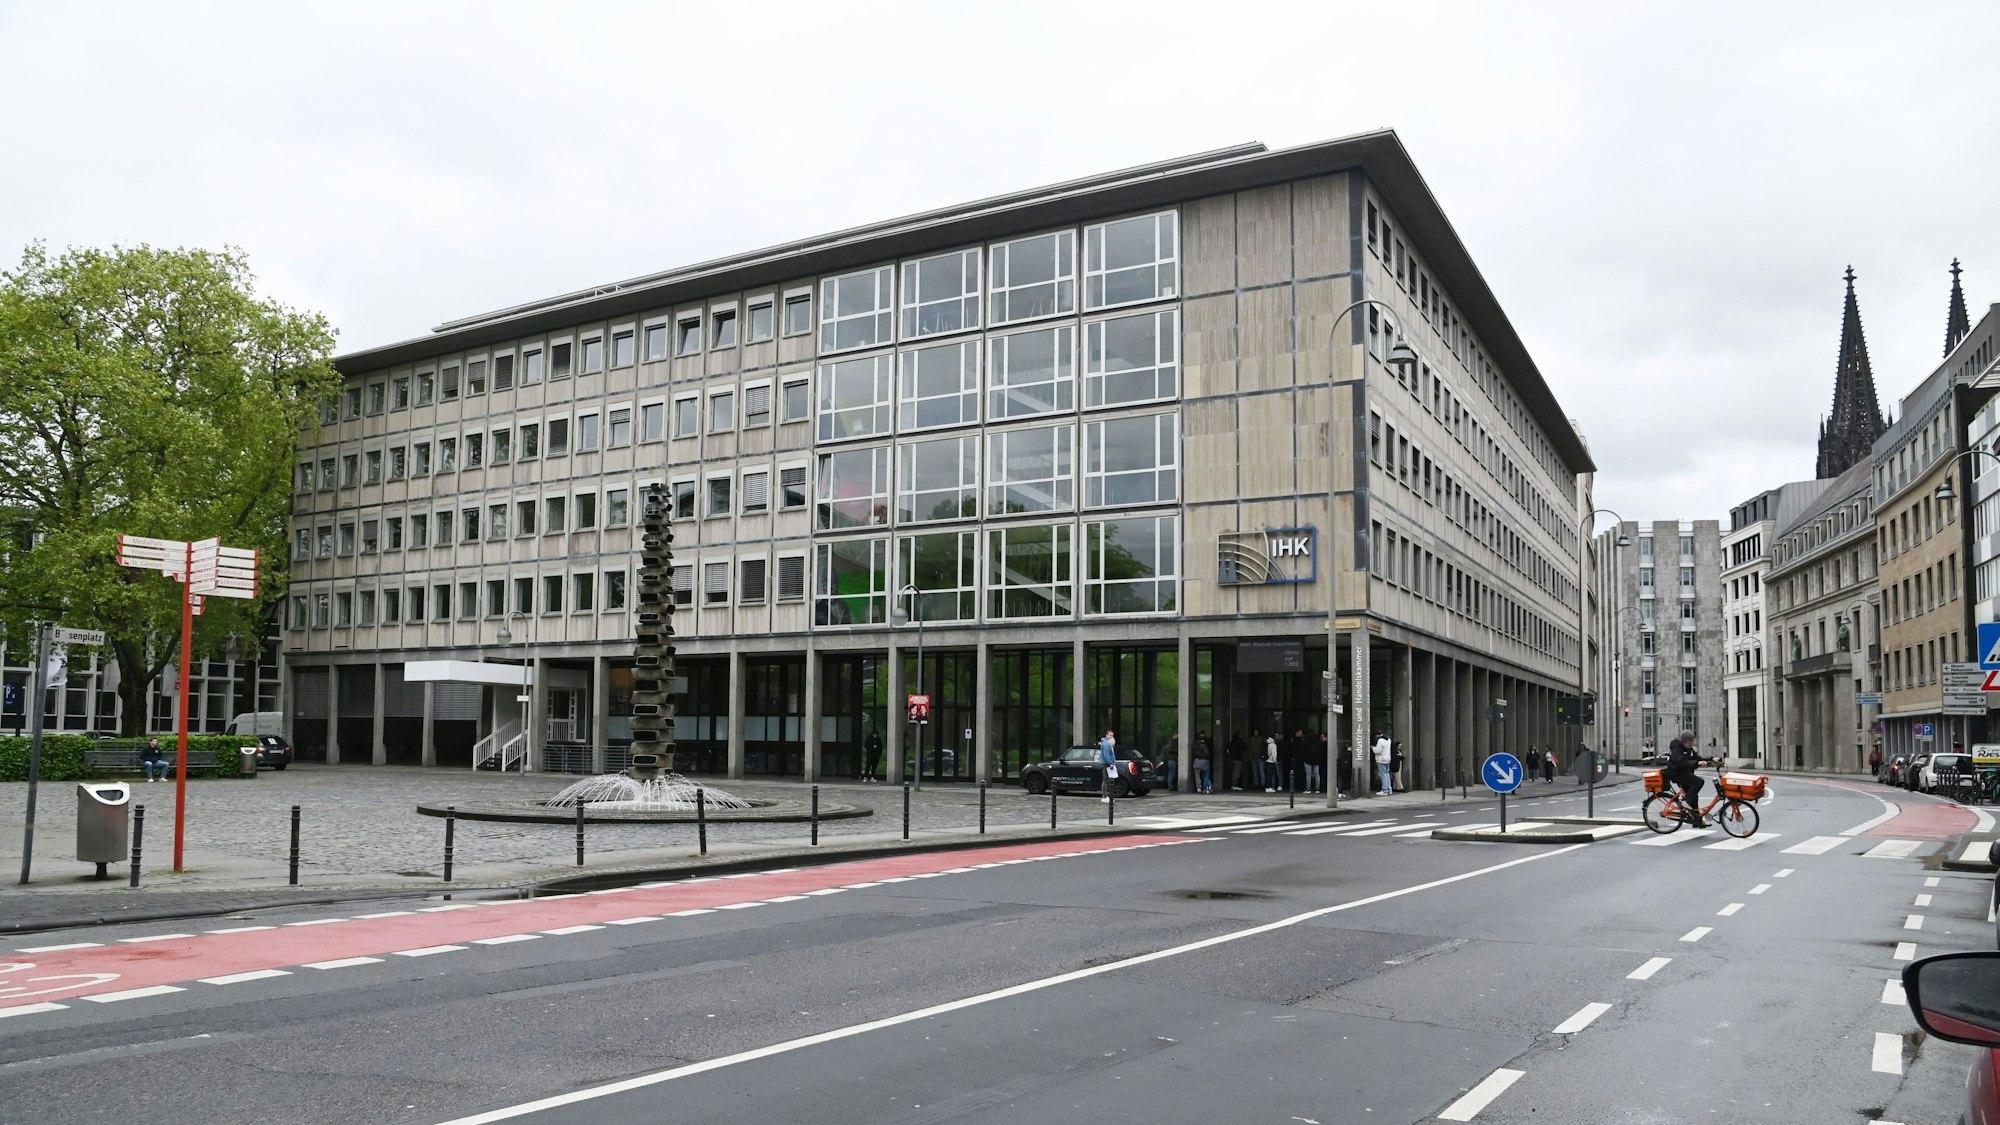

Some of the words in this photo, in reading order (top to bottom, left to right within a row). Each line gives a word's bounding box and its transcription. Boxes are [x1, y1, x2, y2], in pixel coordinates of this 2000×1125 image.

[132, 538, 163, 547] MediaPark
[1272, 537, 1310, 557] IHK
[131, 549, 171, 558] Friesenviertel
[140, 560, 163, 568] Gereon
[1355, 646, 1363, 704] Handelskammer
[1355, 708, 1363, 721] und
[1923, 725, 1931, 735] P
[1355, 724, 1363, 760] Industrie-
